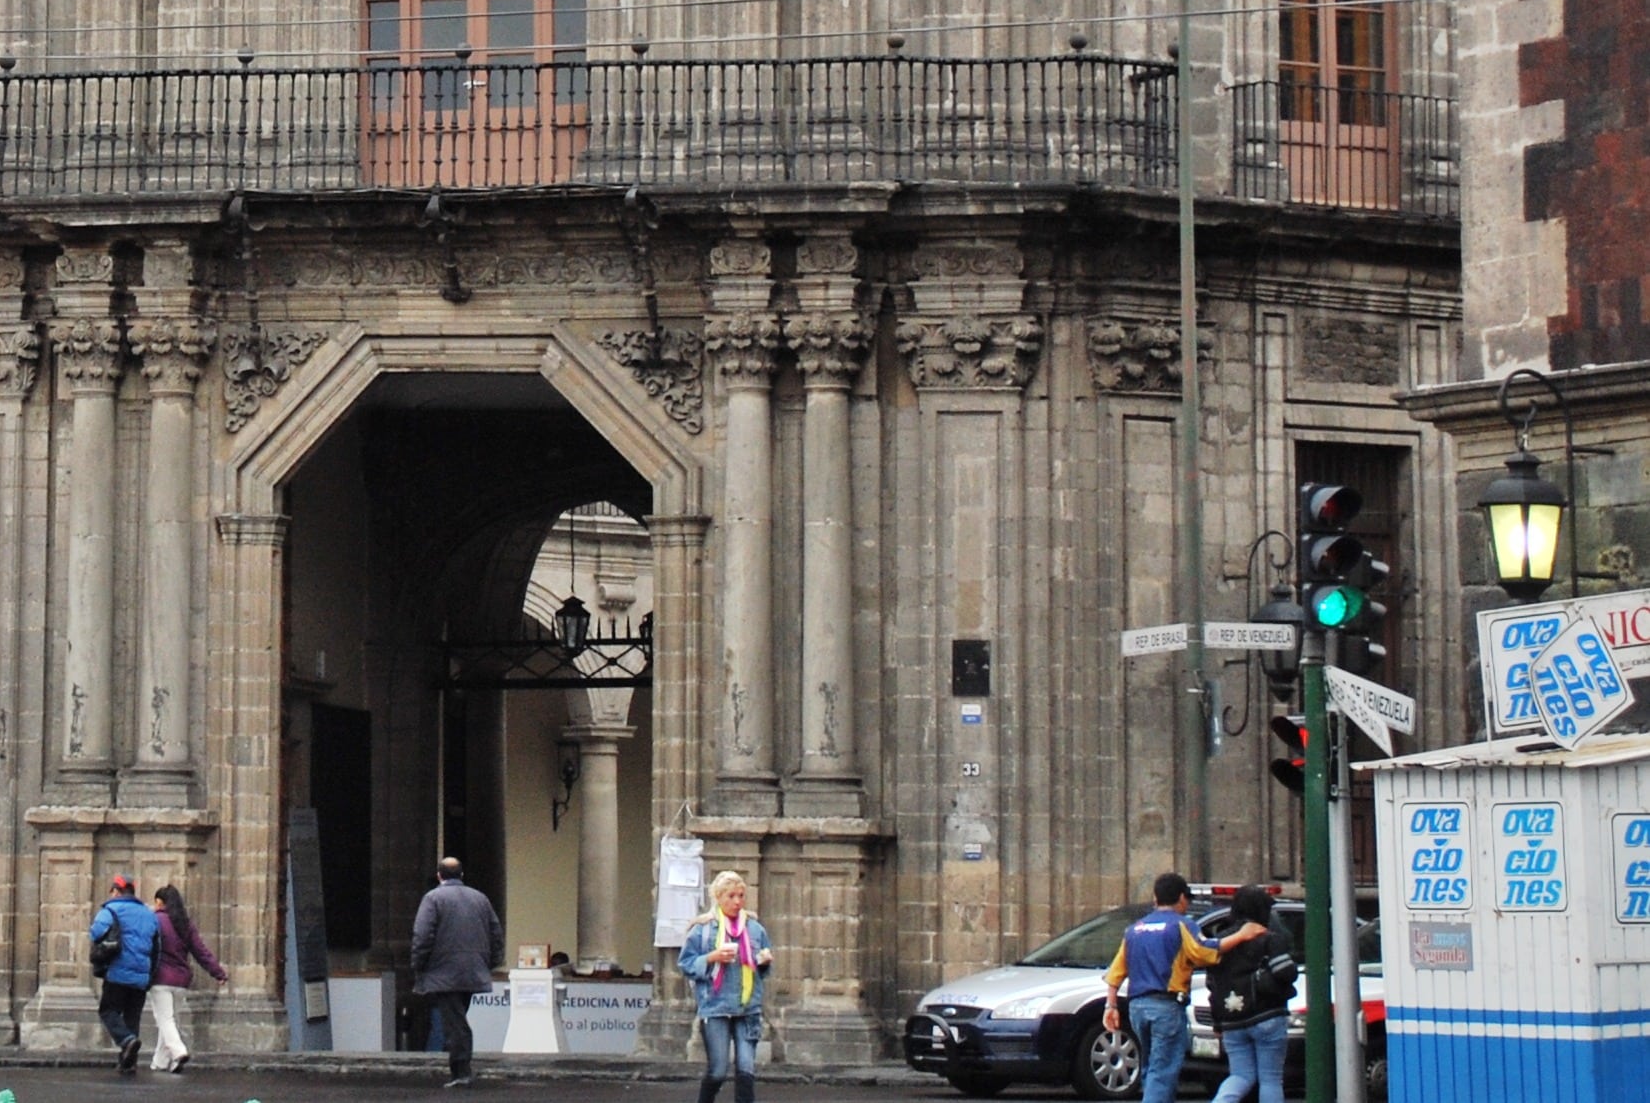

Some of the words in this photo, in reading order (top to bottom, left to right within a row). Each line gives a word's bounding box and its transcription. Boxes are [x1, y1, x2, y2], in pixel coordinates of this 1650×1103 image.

[1237, 629, 1247, 642] DE
[1249, 629, 1291, 643] VENEZUELA
[1502, 618, 1560, 649] ova
[1576, 633, 1621, 699] ova
[1534, 666, 1577, 737] nes
[963, 763, 980, 776] 33
[1410, 808, 1461, 834] ova
[1503, 808, 1556, 835] ova
[1410, 878, 1467, 904] nes
[1503, 879, 1563, 906] nes
[576, 1018, 588, 1030] al
[591, 1018, 636, 1032] público
